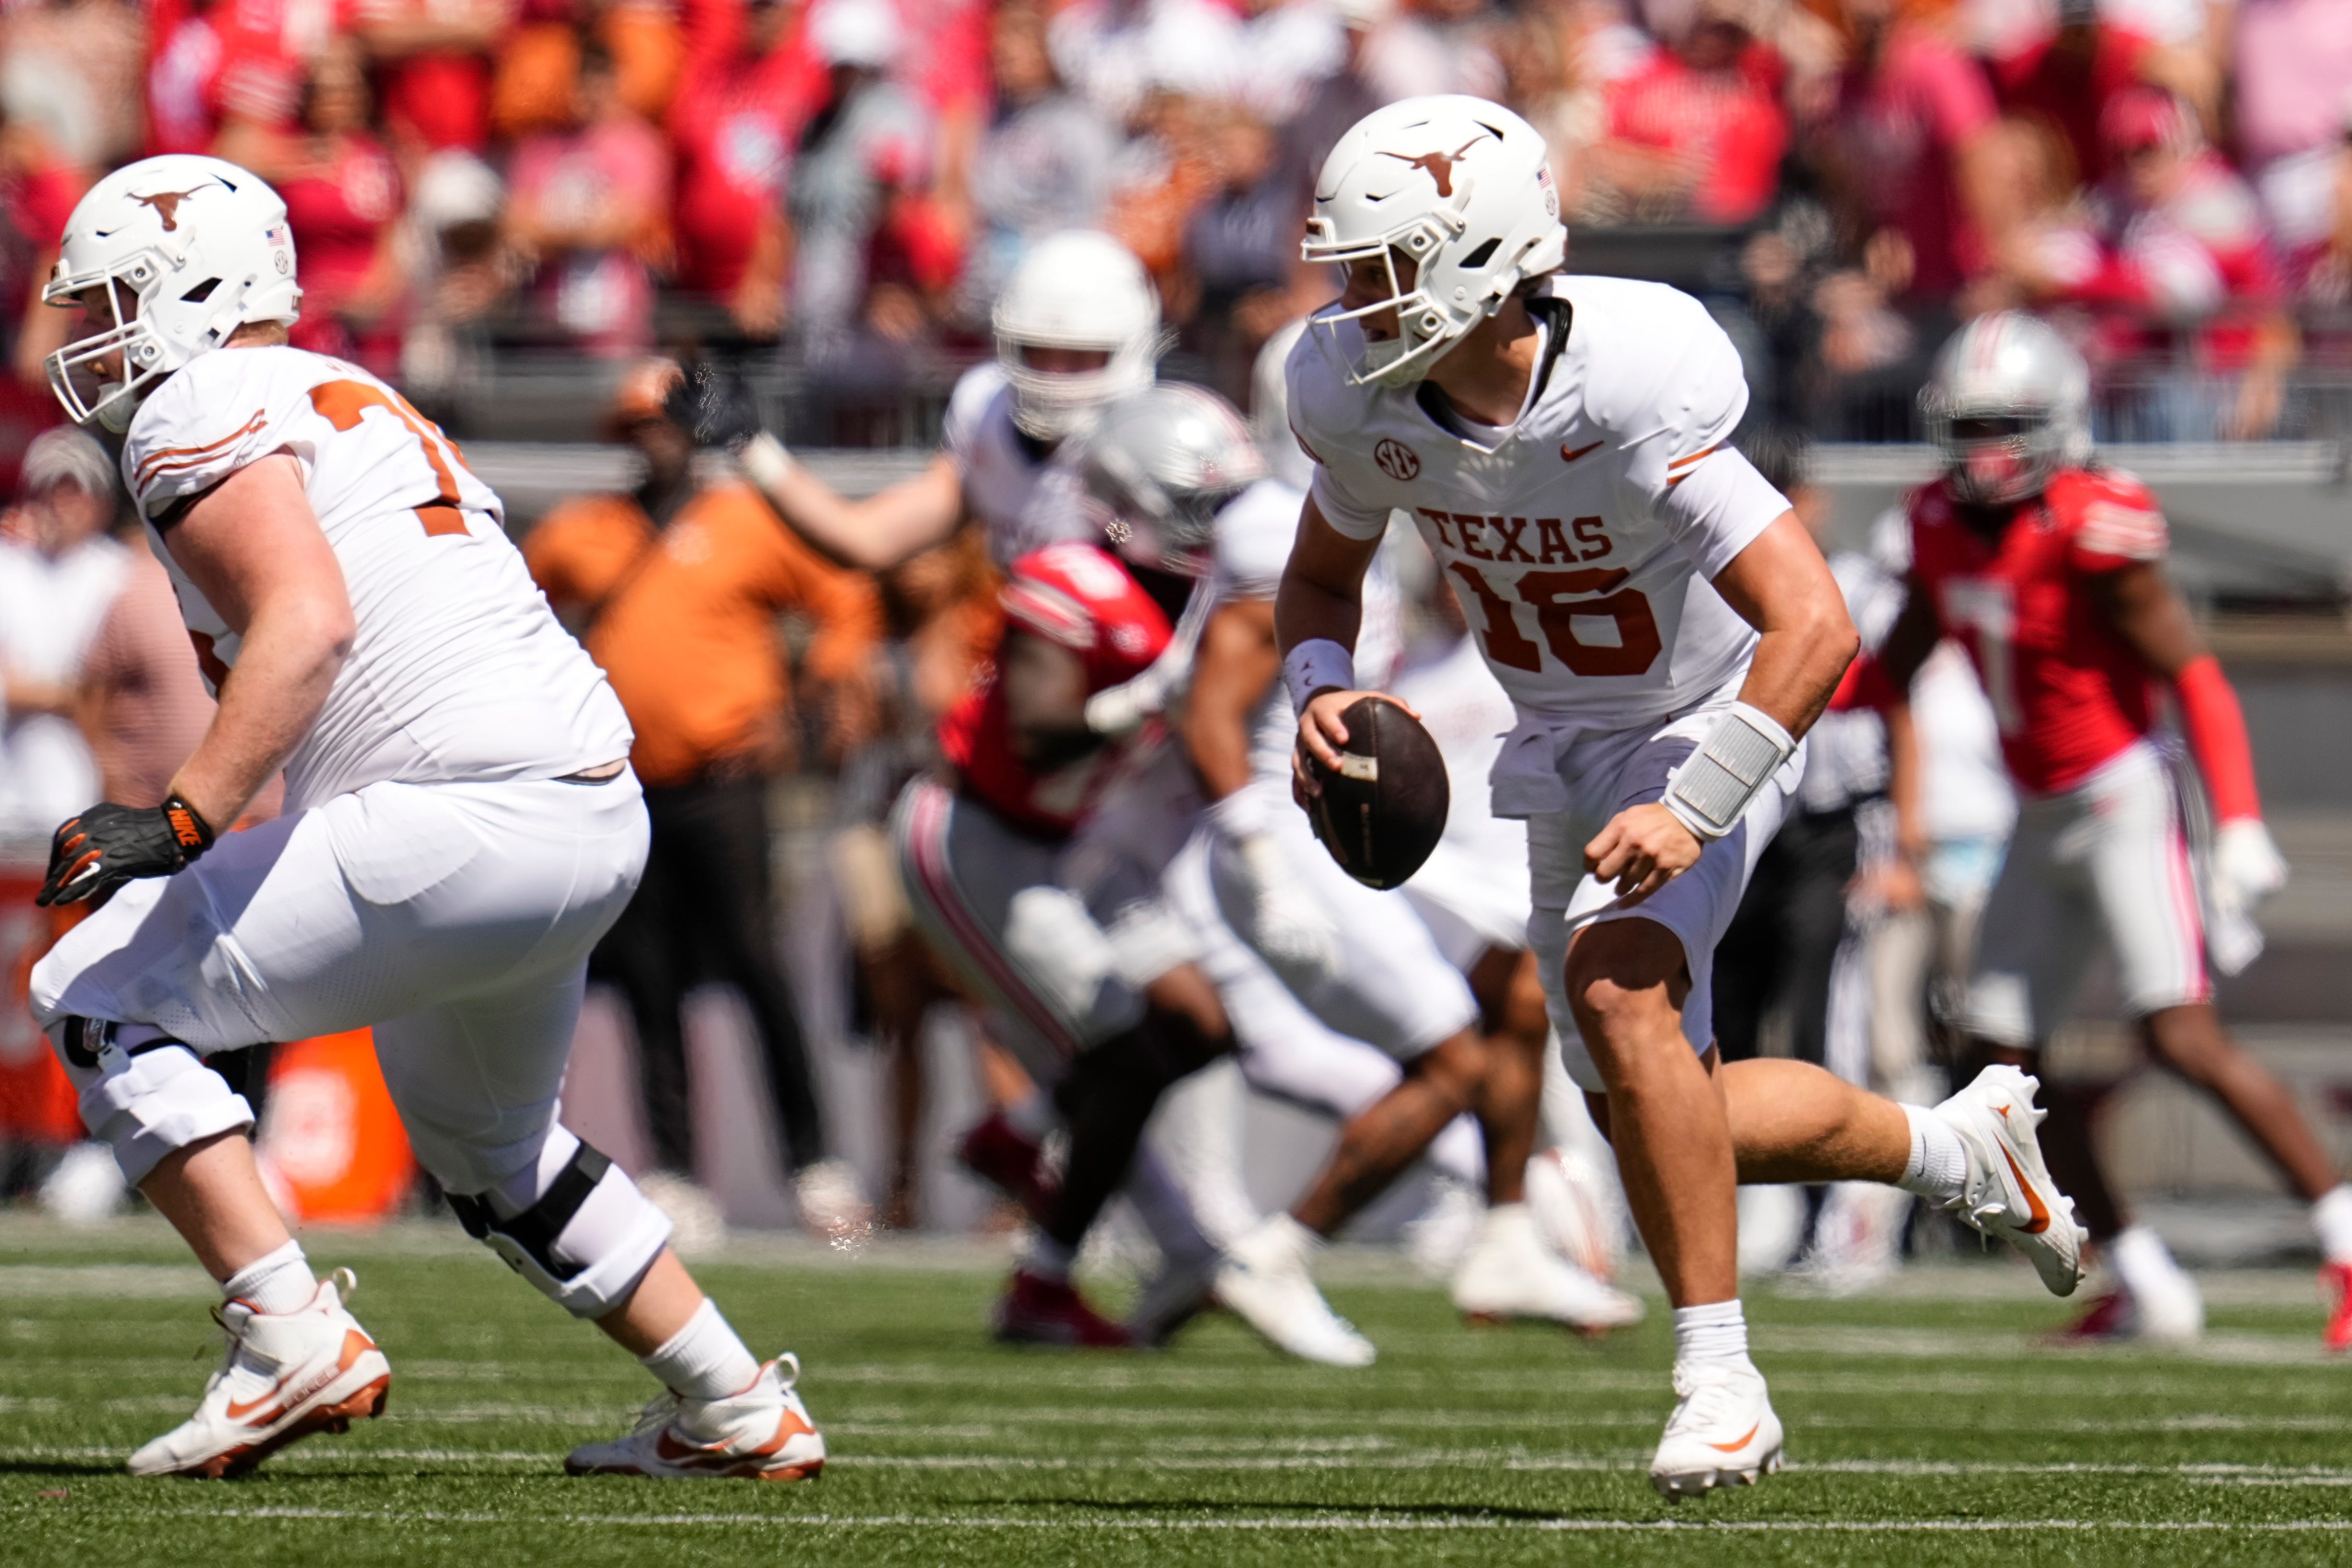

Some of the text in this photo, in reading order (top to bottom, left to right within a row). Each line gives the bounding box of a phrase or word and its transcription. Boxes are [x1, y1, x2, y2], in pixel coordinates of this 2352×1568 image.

[1375, 440, 1419, 479] SEC
[1416, 507, 1612, 564] TEXAS
[1448, 561, 1663, 676] 16
[168, 809, 202, 846] NIKE
